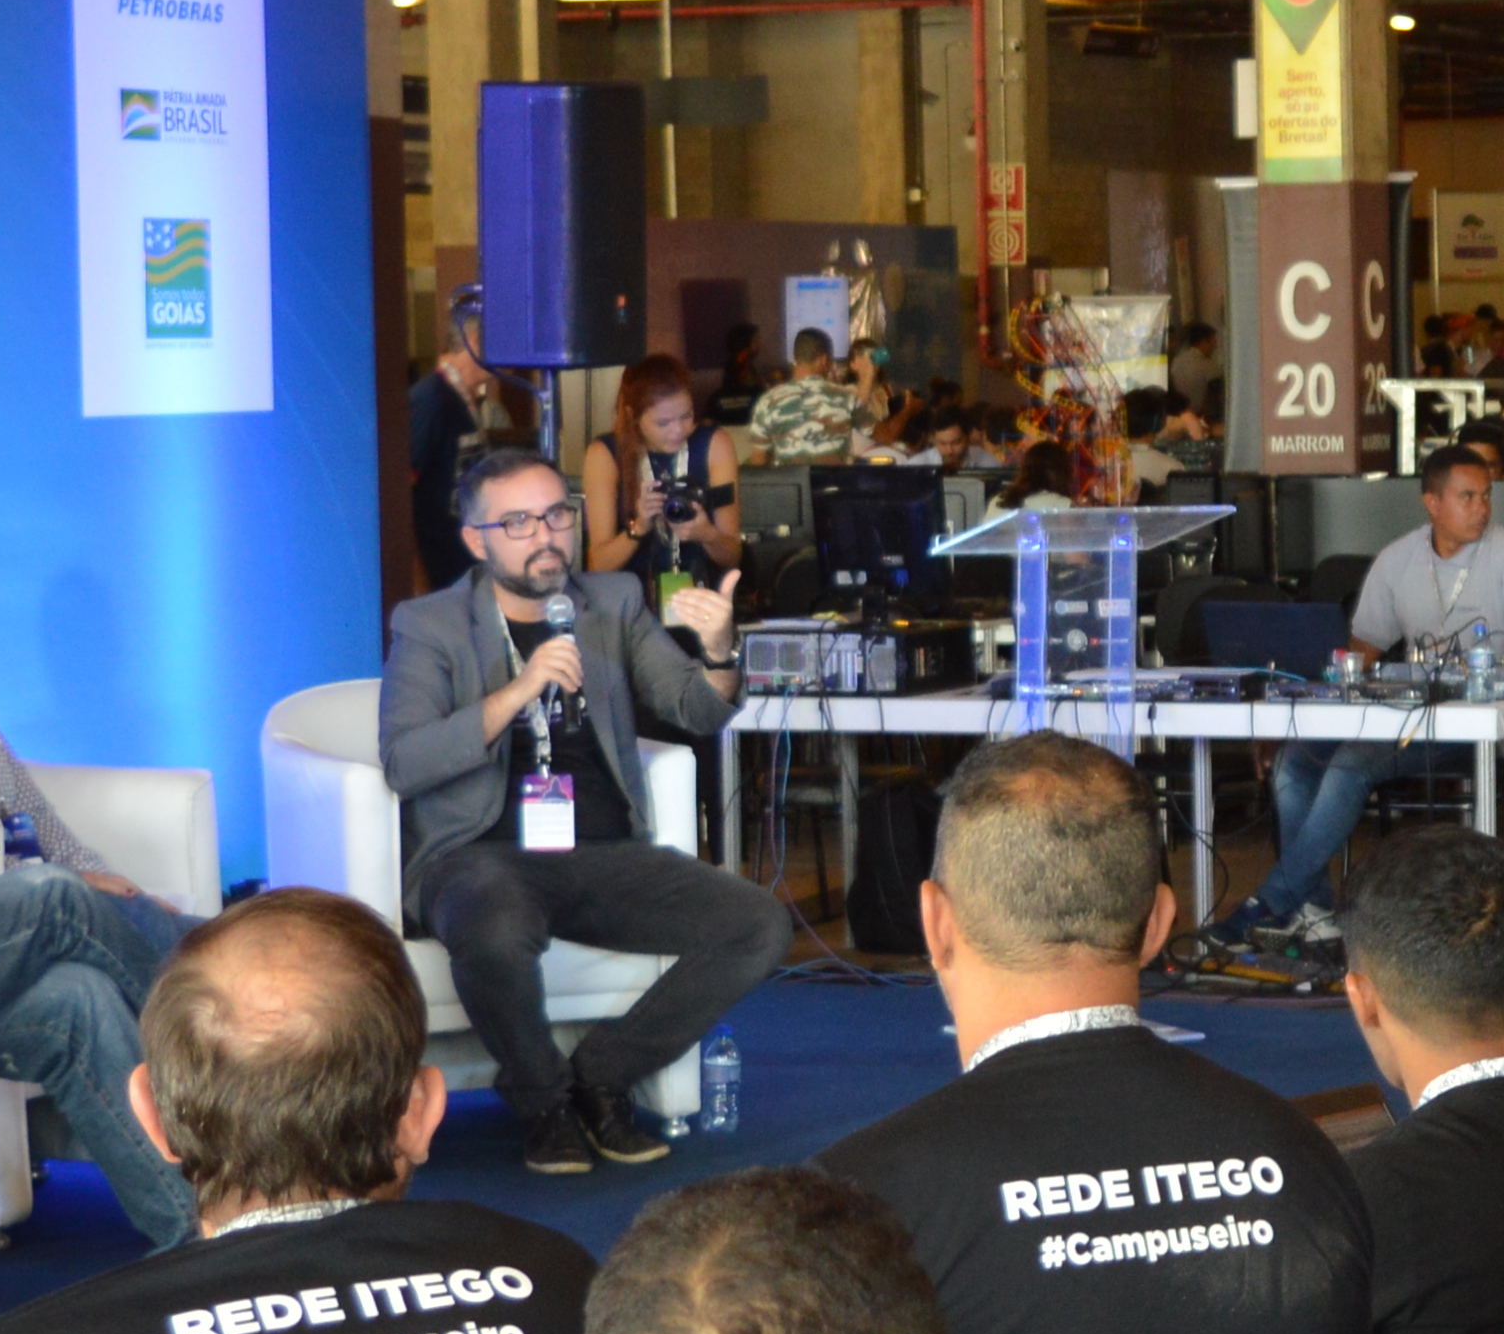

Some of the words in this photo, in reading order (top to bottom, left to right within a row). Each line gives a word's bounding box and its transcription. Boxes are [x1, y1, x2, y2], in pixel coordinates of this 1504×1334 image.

[164, 106, 228, 136] BRASIL
[1279, 260, 1332, 341] C
[1364, 259, 1386, 340] C
[1277, 361, 1337, 418] 20
[1271, 434, 1345, 454] MARROM
[999, 1168, 1136, 1223] REDE
[1140, 1155, 1285, 1206] ITEGO
[1037, 1214, 1275, 1271] #Campuseiro
[351, 1265, 535, 1319] ITEGO
